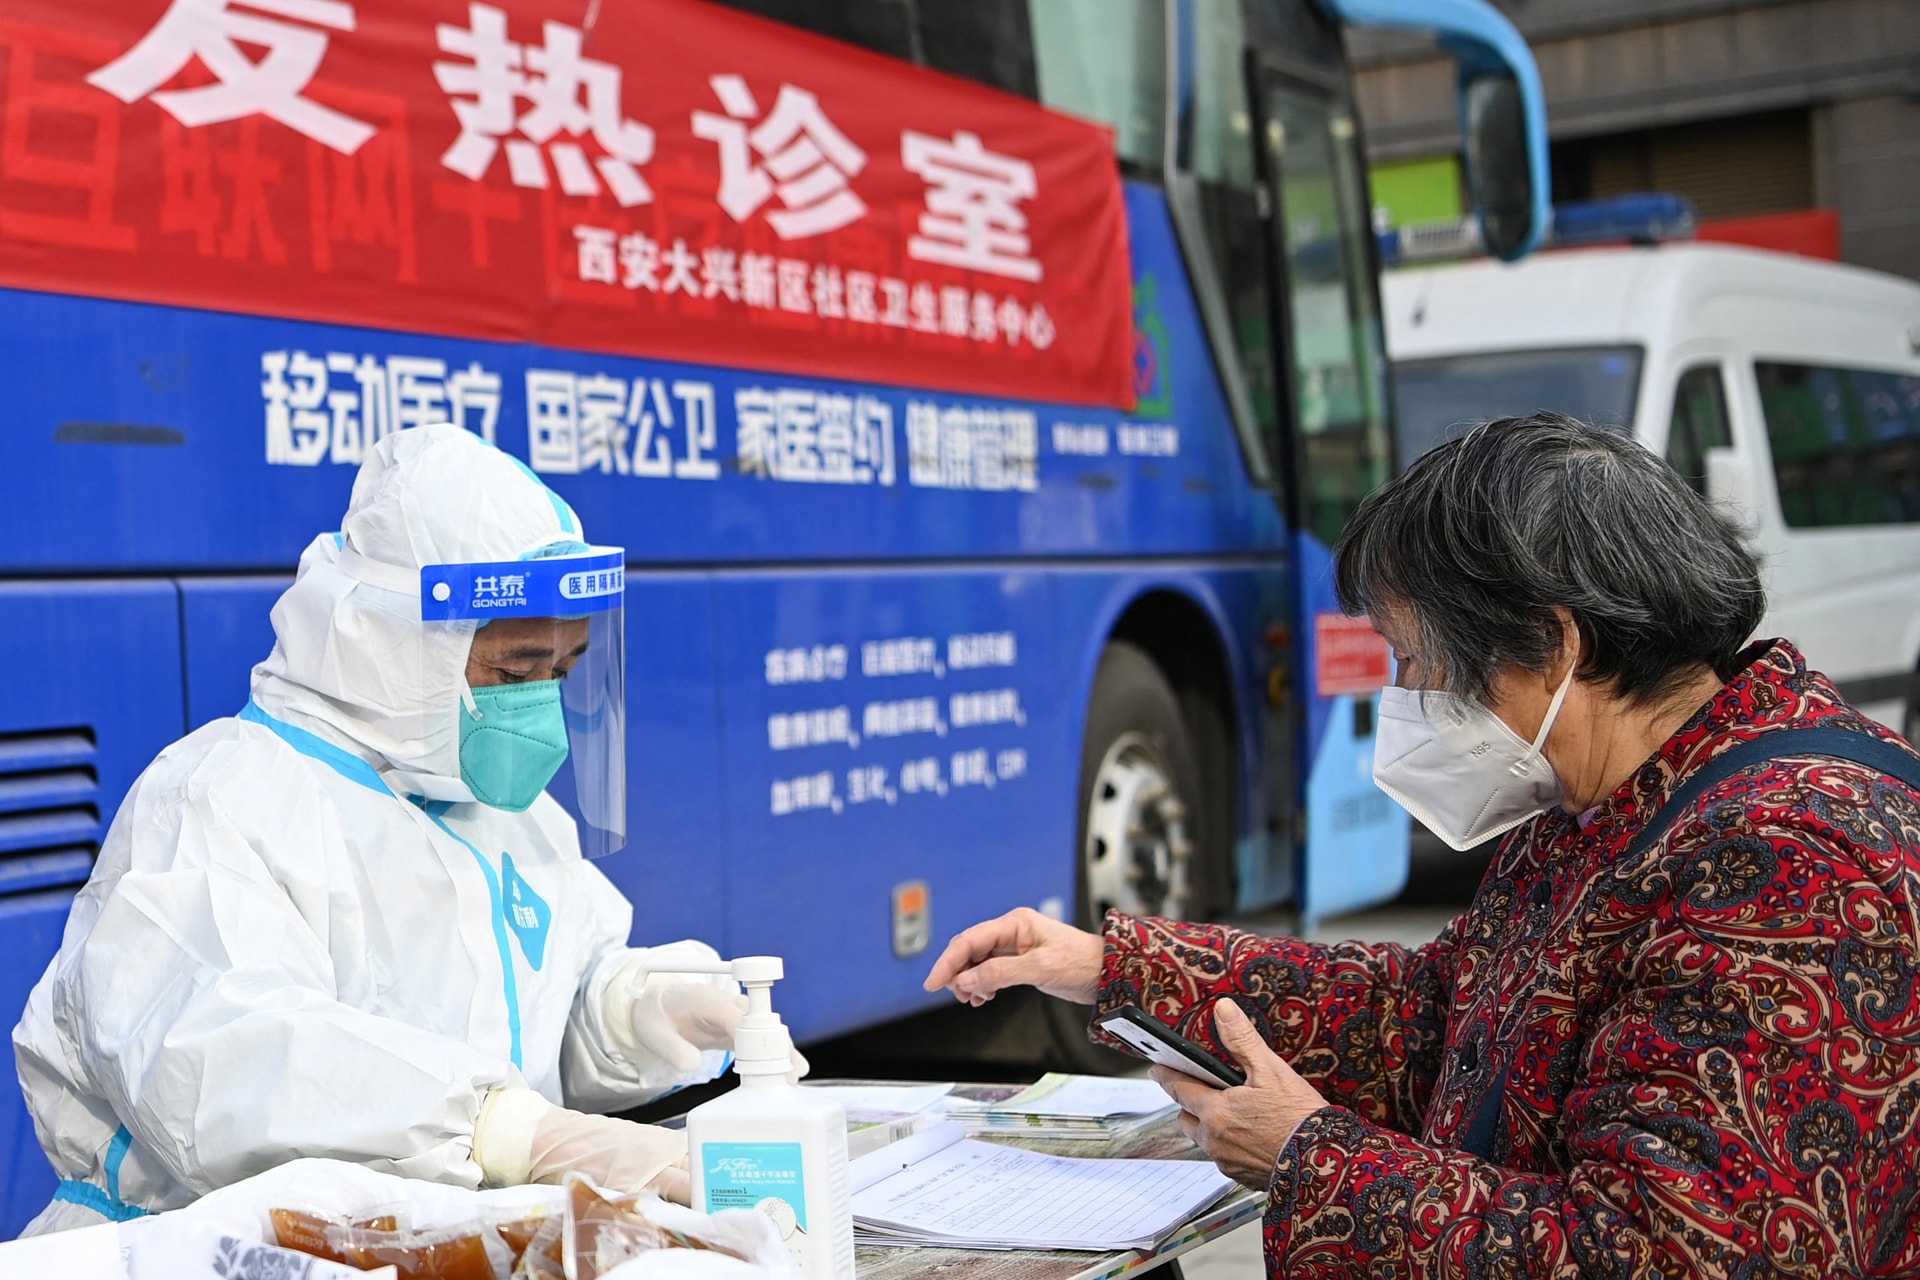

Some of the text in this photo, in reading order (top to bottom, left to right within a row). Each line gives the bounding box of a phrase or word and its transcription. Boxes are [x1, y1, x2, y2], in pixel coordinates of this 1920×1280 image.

[87, 0, 1043, 283] 发热诊室
[572, 224, 1056, 350] 西安大兴新区社区卫生服务中心
[261, 350, 501, 467] 移动医疗
[526, 368, 721, 480] 国家公卫
[733, 386, 897, 486] 家医签约
[472, 598, 527, 608] GONGTAI
[474, 574, 525, 598] 共泰
[1470, 741, 1492, 758] N95
